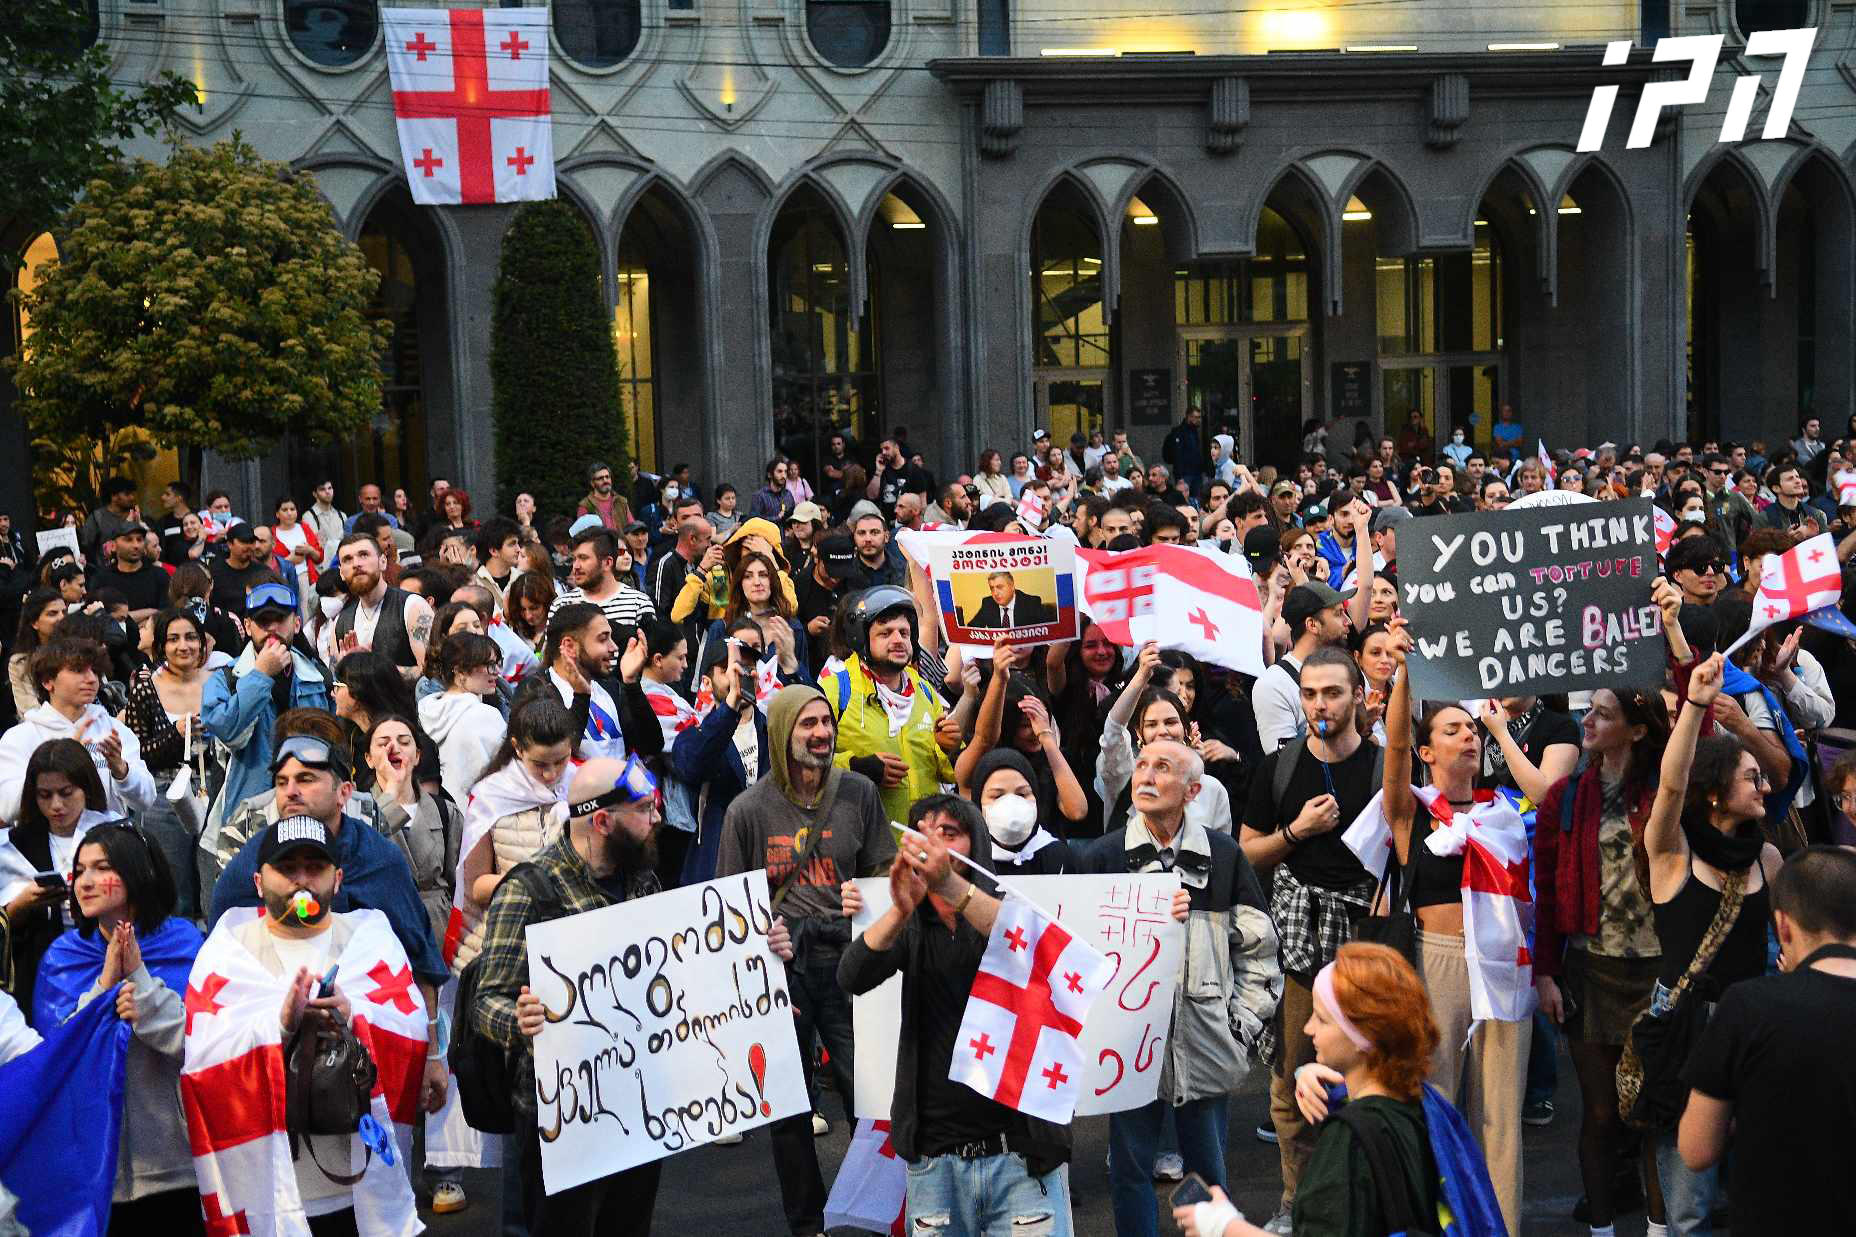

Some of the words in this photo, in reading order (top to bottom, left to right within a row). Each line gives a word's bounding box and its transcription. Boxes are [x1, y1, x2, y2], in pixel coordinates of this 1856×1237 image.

[952, 549, 1005, 559] პუტინის
[1431, 531, 1524, 572] YOU
[1541, 514, 1651, 554] THINK
[1404, 581, 1456, 604] you
[1470, 572, 1516, 594] can
[1501, 588, 1567, 620] US?
[1418, 630, 1474, 660] WE
[1493, 618, 1567, 653] ARE
[1478, 645, 1629, 690] DANCERS
[577, 799, 599, 814] FOX
